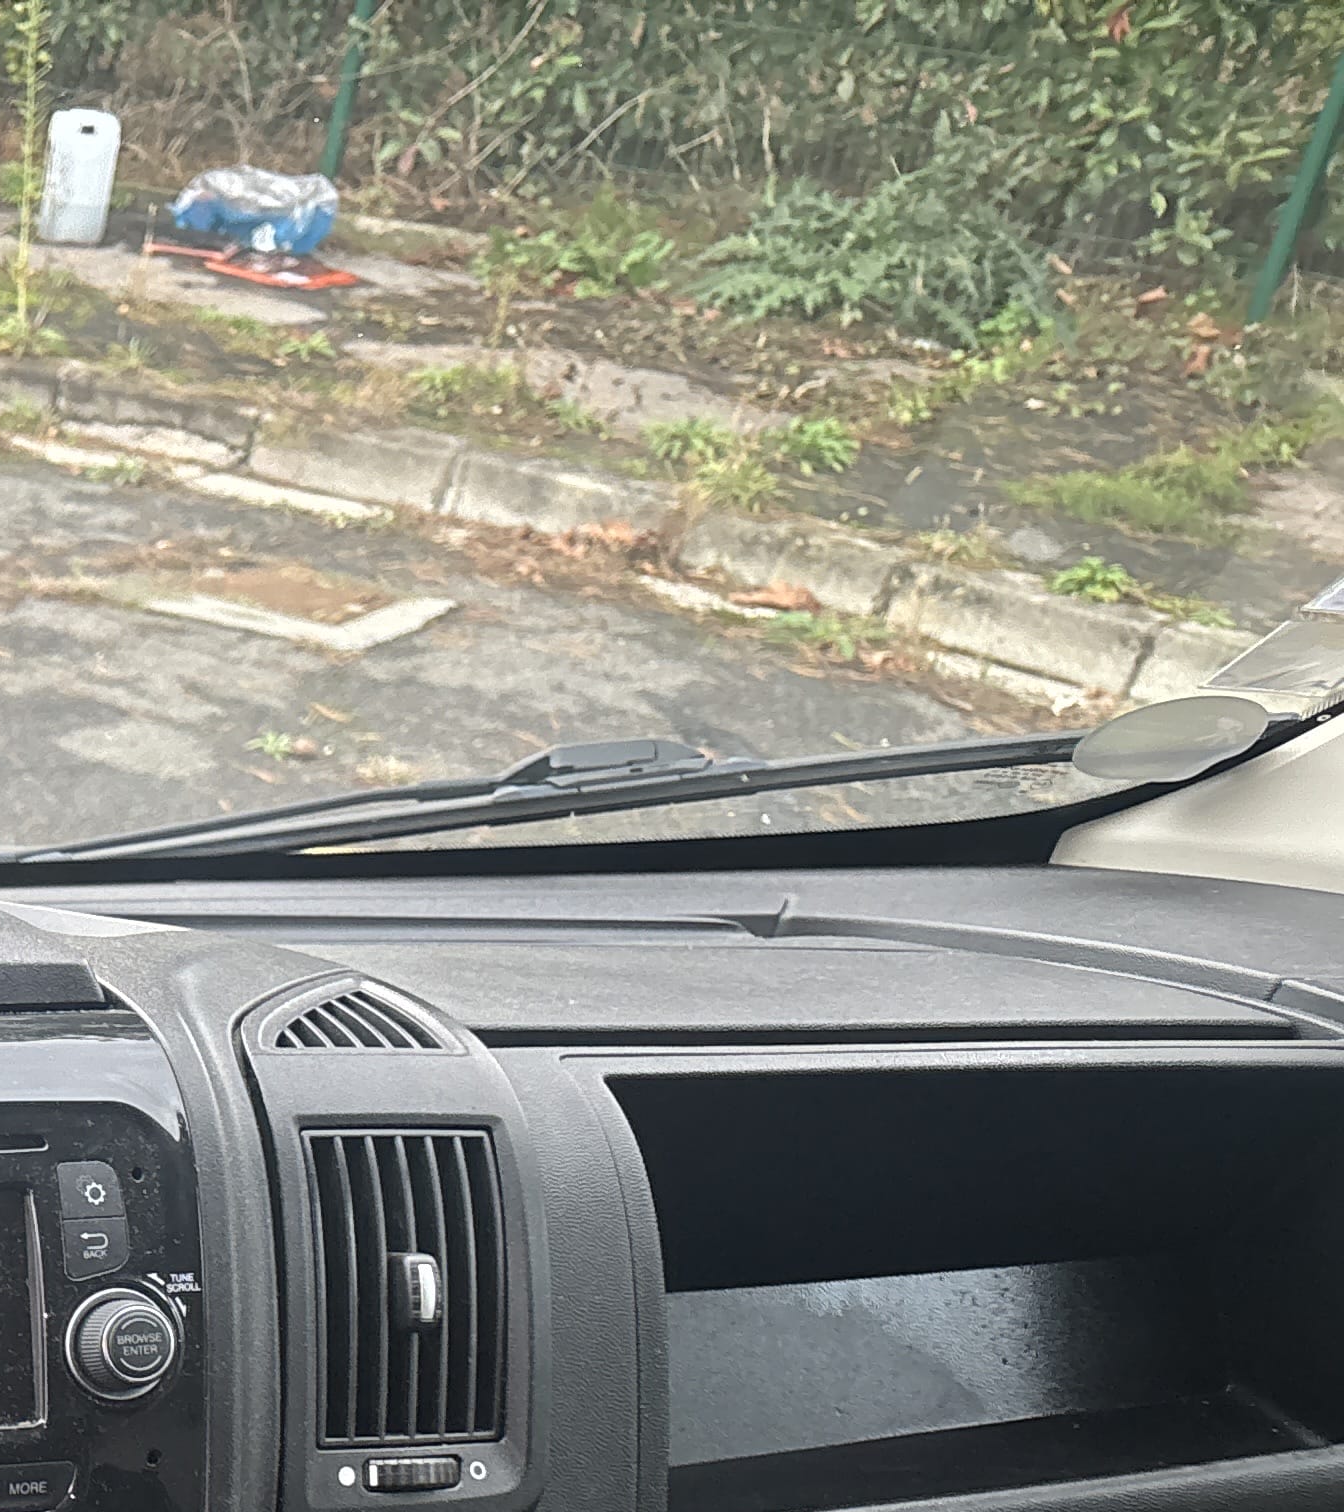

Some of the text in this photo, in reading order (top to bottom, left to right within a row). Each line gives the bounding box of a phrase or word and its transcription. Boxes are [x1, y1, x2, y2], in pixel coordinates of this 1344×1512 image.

[83, 1249, 108, 1260] BACK
[169, 1272, 195, 1282] TUNE
[165, 1282, 202, 1293] SCROLL
[116, 1333, 163, 1346] BROWSE
[122, 1345, 158, 1357] ENTER
[7, 1479, 49, 1497] MORE
